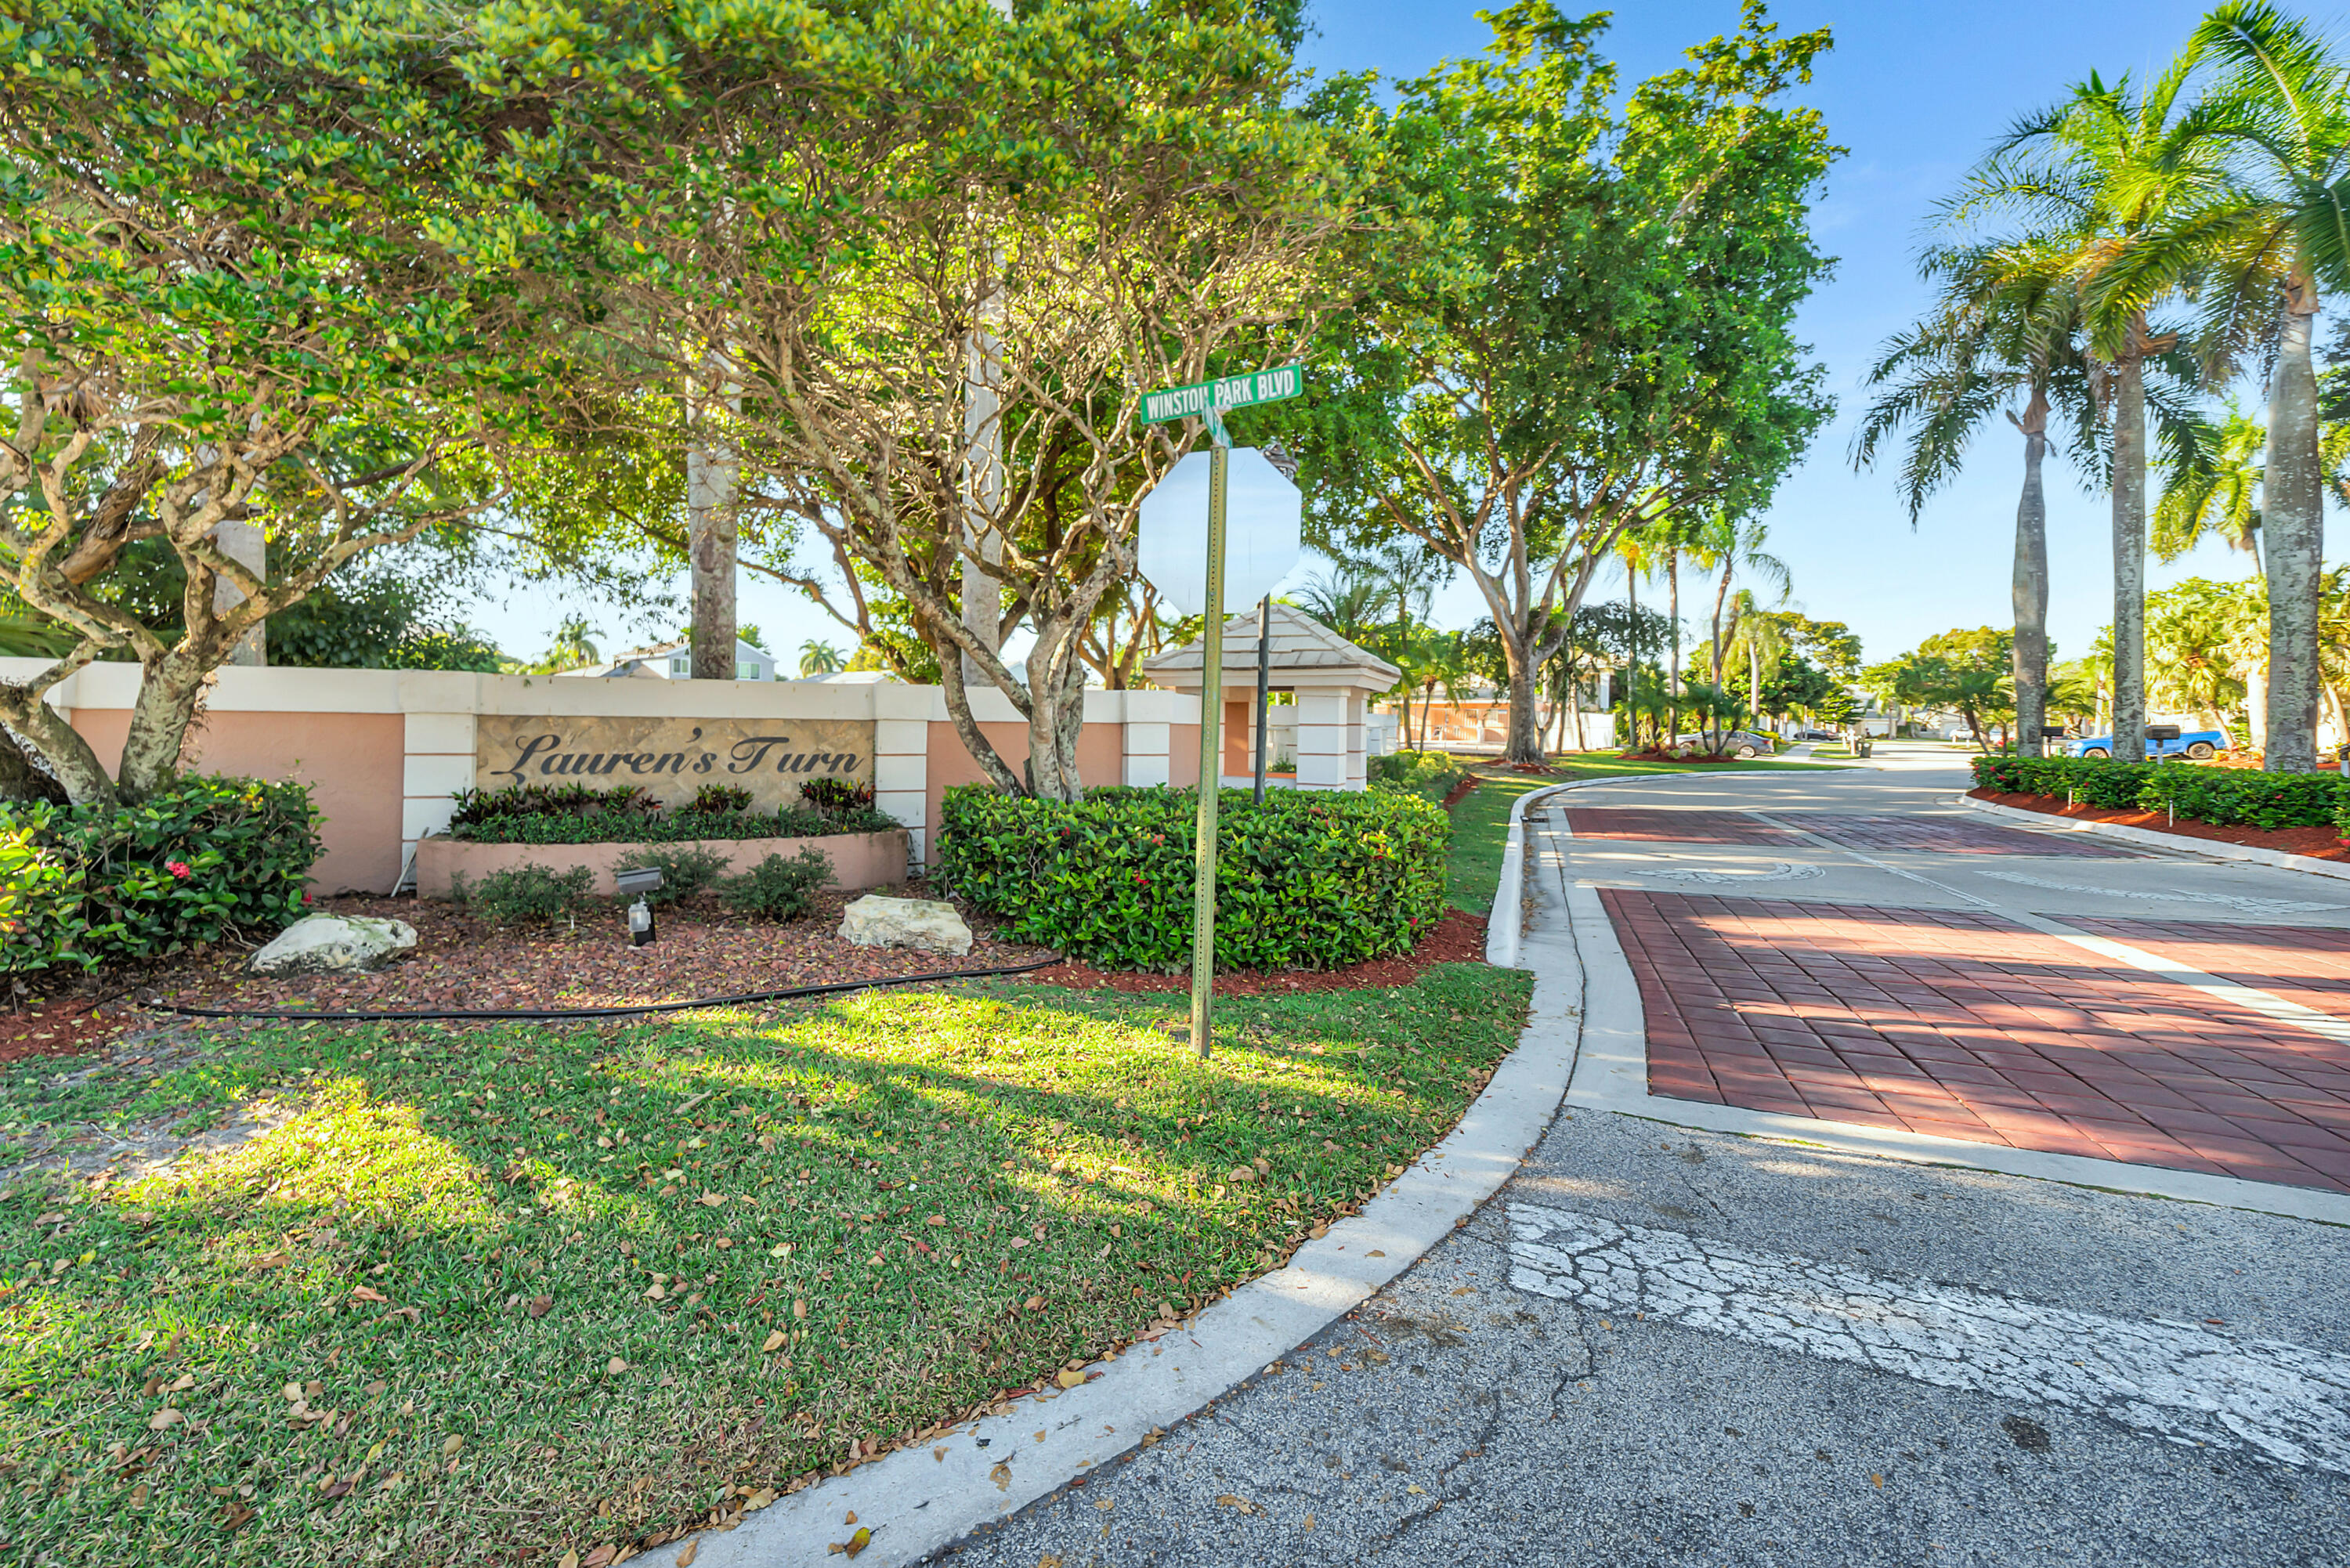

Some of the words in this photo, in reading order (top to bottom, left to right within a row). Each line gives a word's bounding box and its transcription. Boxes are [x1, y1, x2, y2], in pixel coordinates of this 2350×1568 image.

[1215, 377, 1253, 406] PARK
[1257, 369, 1295, 401] BLVD
[490, 727, 718, 785] Lauren's
[727, 735, 866, 775] Turn
